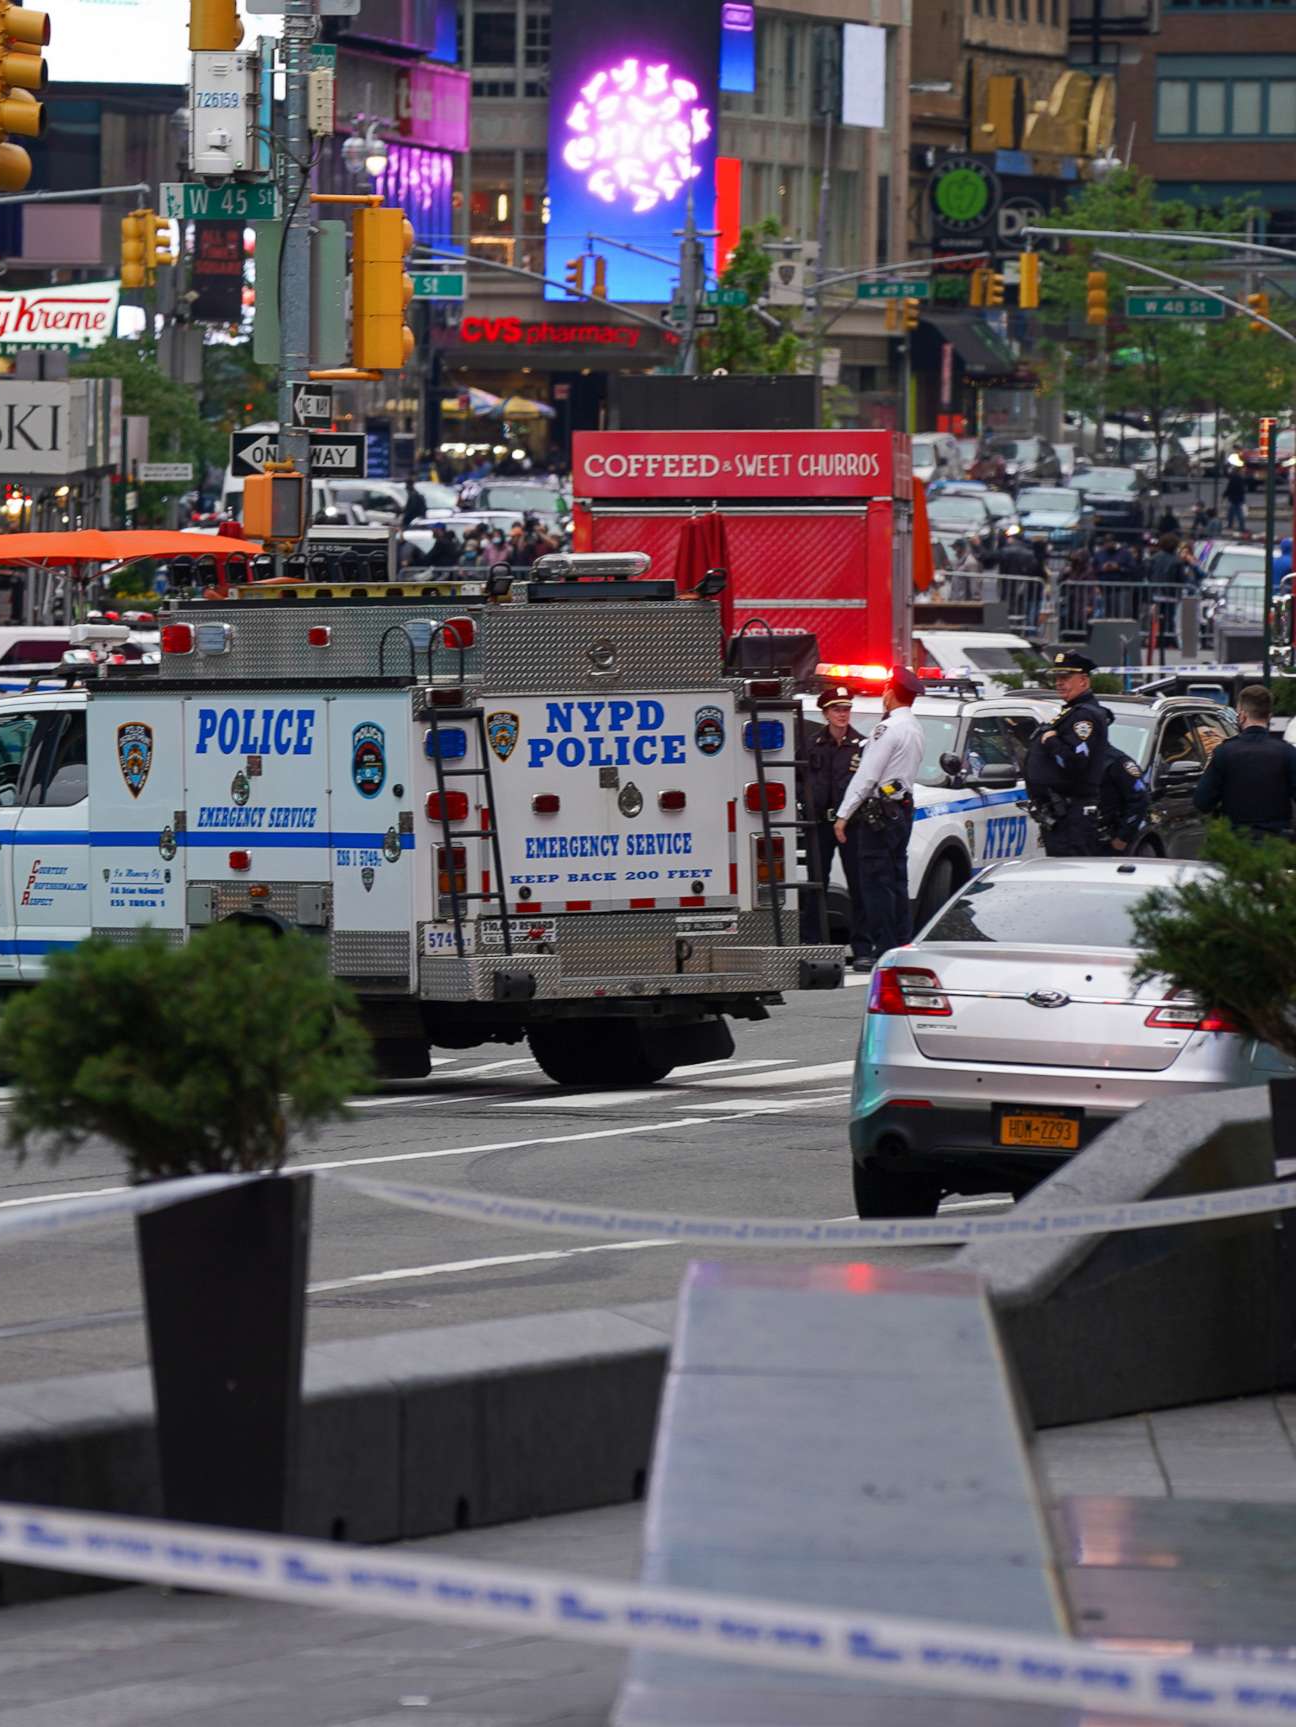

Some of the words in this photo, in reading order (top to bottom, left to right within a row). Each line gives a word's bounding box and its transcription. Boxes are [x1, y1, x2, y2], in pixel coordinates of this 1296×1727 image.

[196, 91, 240, 108] 726159
[189, 189, 208, 214] W
[221, 189, 247, 214] 45
[258, 189, 273, 205] St
[423, 277, 439, 293] St
[14, 296, 110, 332] Kreme
[1145, 301, 1159, 312] W
[1190, 301, 1206, 312] St
[460, 316, 523, 343] CVS
[525, 321, 641, 348] pharmacy
[299, 397, 312, 413] ONE
[315, 397, 329, 414] WAY
[310, 448, 348, 465] WAY
[584, 453, 720, 477] COFFEED
[722, 461, 732, 472] &
[735, 453, 792, 477] SWEET
[798, 453, 880, 477] CHURROS
[546, 700, 665, 733] NYPD
[195, 708, 316, 755] POLICE
[528, 735, 686, 768] POLICE
[197, 806, 266, 827] EMERGENCY
[268, 807, 318, 828] SERVICE
[525, 834, 620, 859] EMERGENCY
[626, 832, 693, 856] SERVICE
[982, 815, 1028, 860] NYPD
[510, 874, 559, 884] KEEP
[567, 872, 617, 883] BACK
[625, 870, 659, 881] 200
[667, 869, 713, 879] FEET
